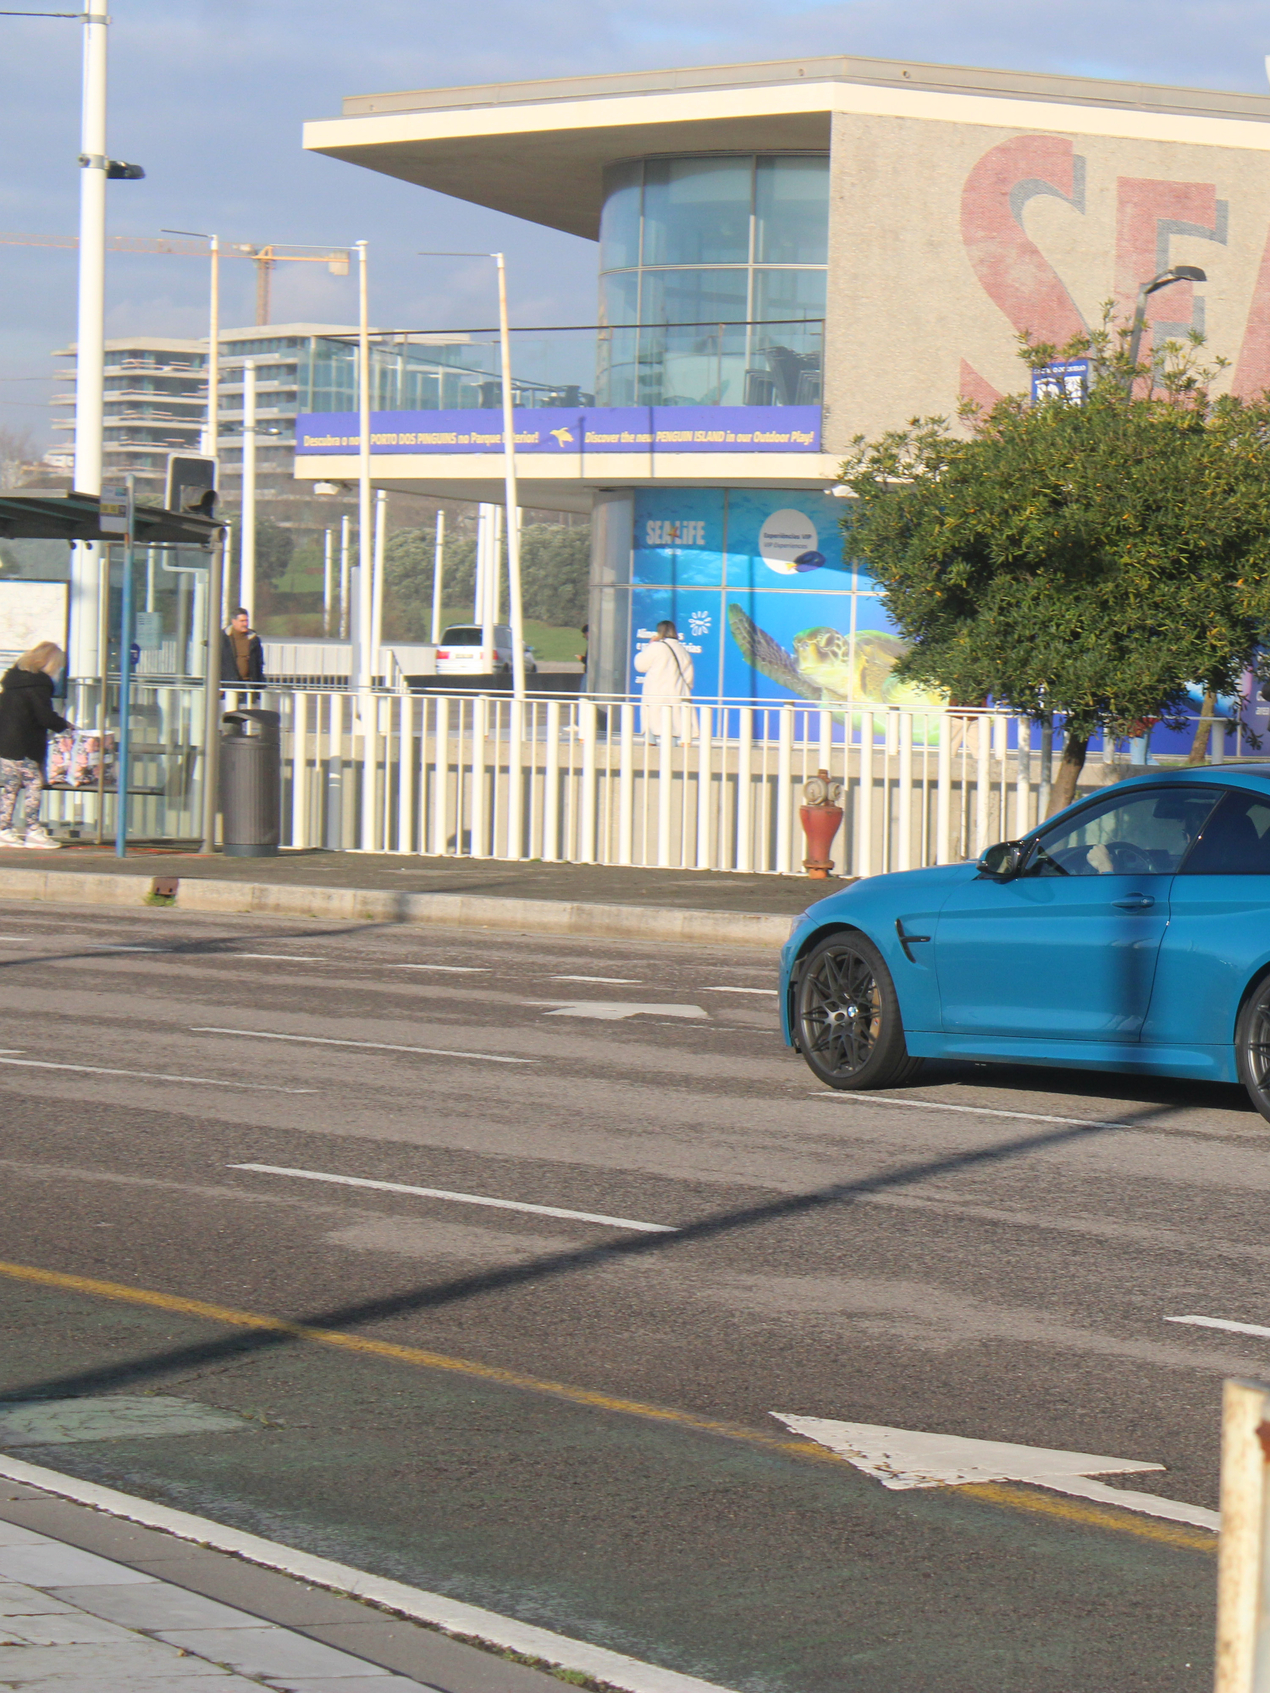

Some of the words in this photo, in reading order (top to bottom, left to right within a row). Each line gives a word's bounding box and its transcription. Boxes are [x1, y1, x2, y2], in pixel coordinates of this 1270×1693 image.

[303, 435, 340, 446] Descubra
[341, 437, 348, 445] o
[370, 433, 397, 445] PORTO
[398, 433, 416, 445] DOS
[417, 432, 457, 444] PINGUINS
[457, 435, 469, 444] no
[471, 432, 502, 446] Parque
[585, 432, 619, 443] Discover
[620, 431, 634, 443] the
[635, 434, 653, 443] new
[656, 431, 692, 443] PENGUIN
[694, 431, 724, 442] ISLAND
[725, 430, 735, 442] in
[736, 433, 752, 442] our
[753, 431, 789, 443] Outdoor
[790, 431, 814, 446] Play!
[646, 520, 672, 545] SEA
